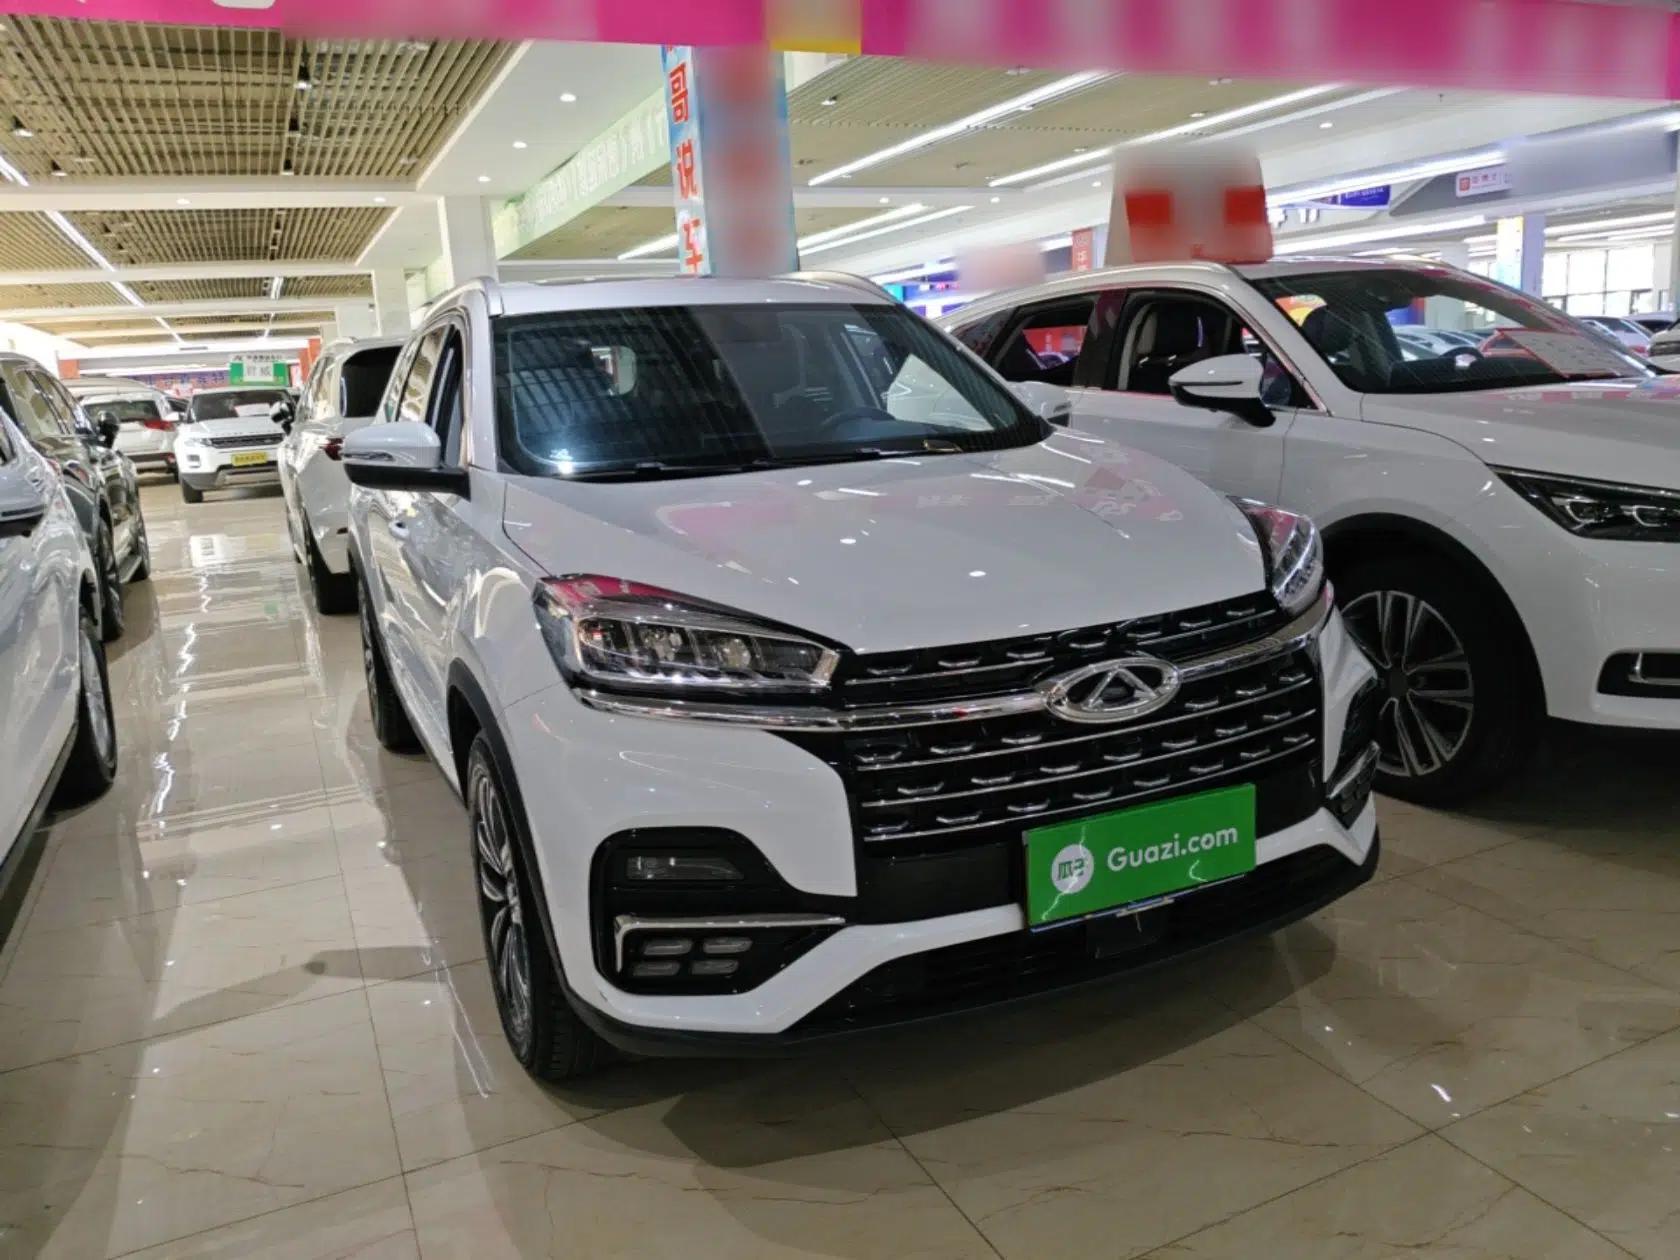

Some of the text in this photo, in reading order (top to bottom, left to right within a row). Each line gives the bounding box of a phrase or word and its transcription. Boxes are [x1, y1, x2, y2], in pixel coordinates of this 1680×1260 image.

[666, 46, 703, 273] 哥说车
[1106, 826, 1238, 872] Guazi.com
